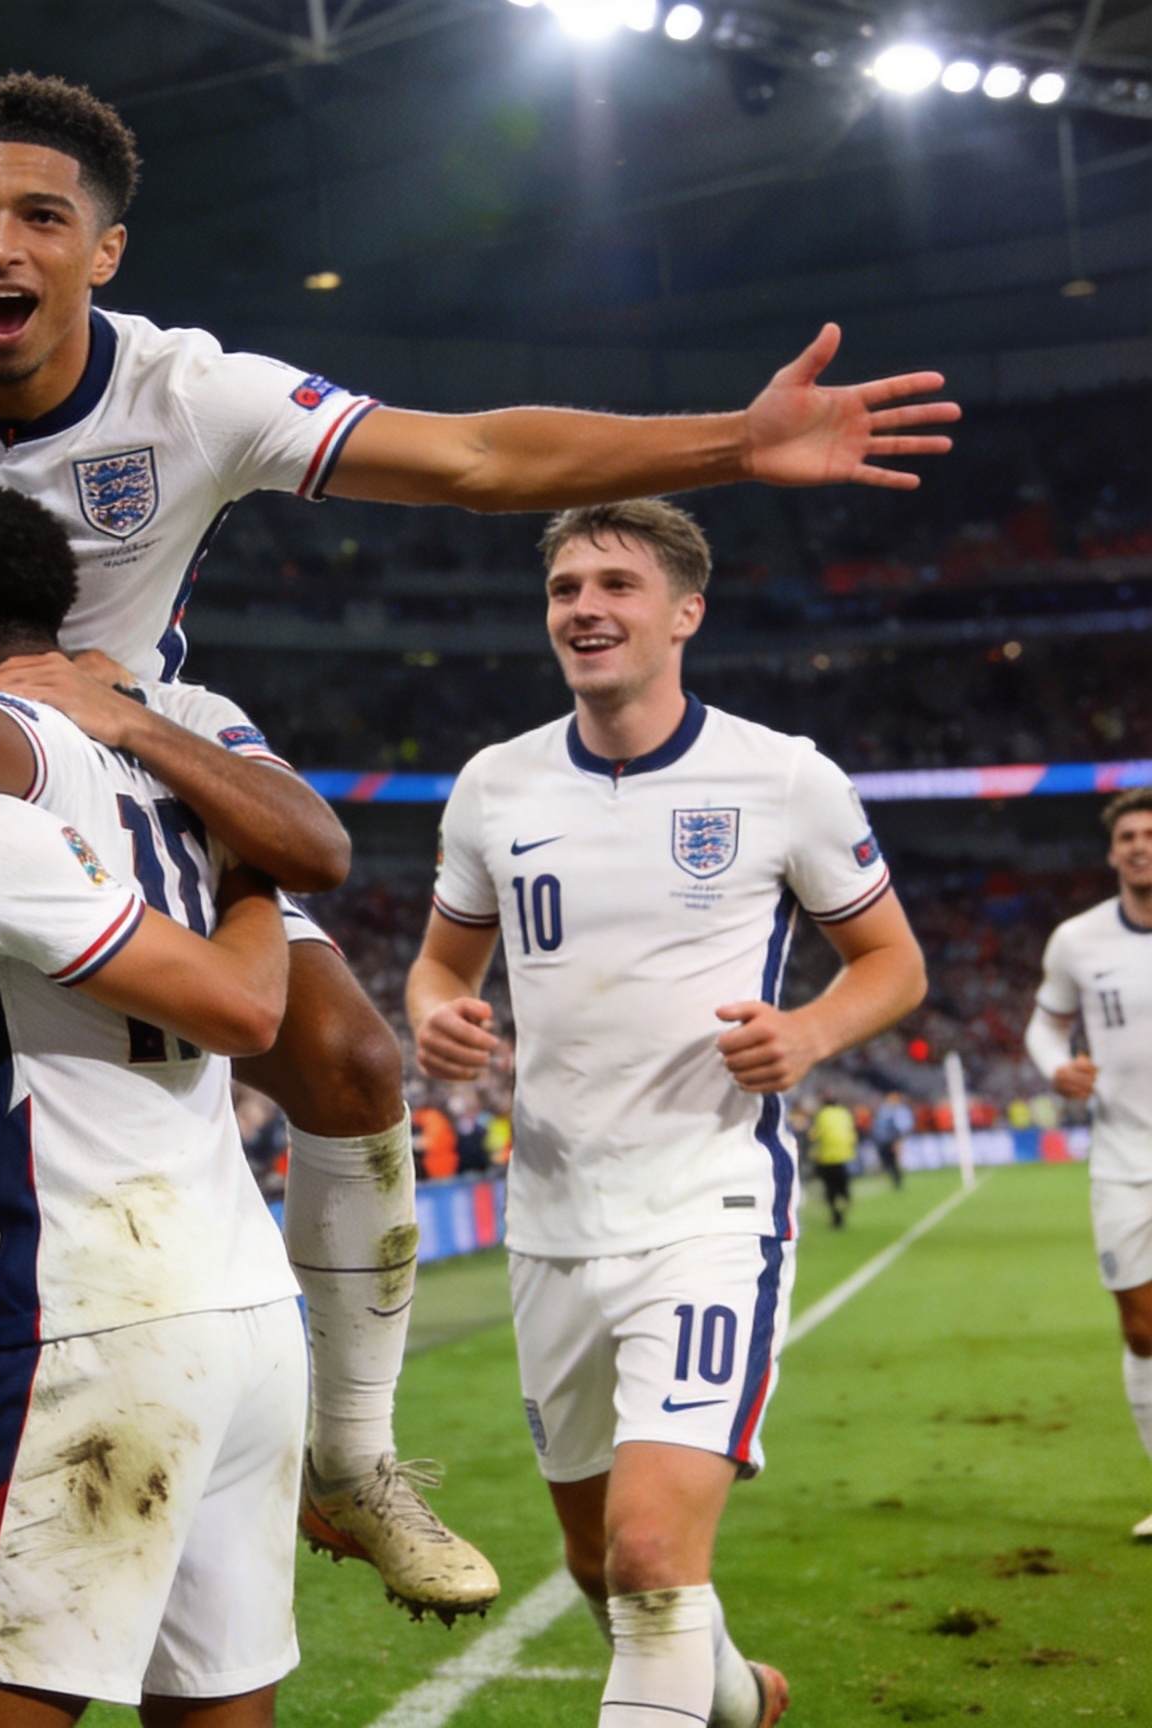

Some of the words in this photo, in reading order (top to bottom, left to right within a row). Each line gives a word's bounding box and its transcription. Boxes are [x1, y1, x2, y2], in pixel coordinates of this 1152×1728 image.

[511, 873, 563, 955] 10
[1099, 990, 1125, 1027] 11
[674, 1304, 737, 1385] 10
